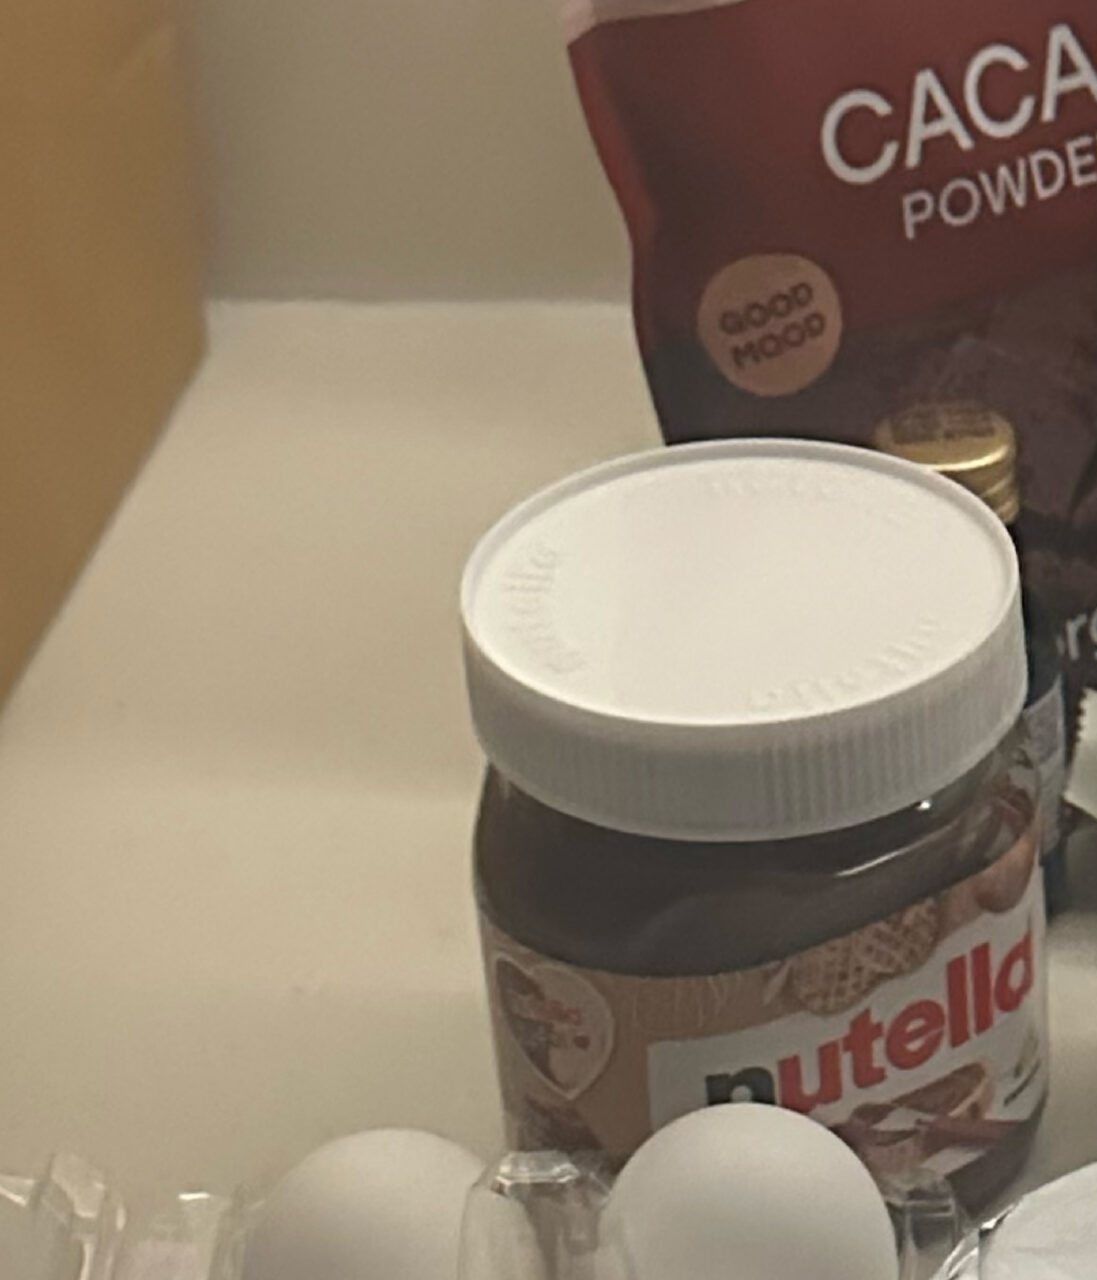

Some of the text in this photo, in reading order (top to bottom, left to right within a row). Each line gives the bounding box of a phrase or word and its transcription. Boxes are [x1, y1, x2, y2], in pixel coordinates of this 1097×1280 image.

[717, 281, 815, 337] GOOD
[730, 311, 826, 371] MOOD
[704, 931, 1036, 1113] nutella
